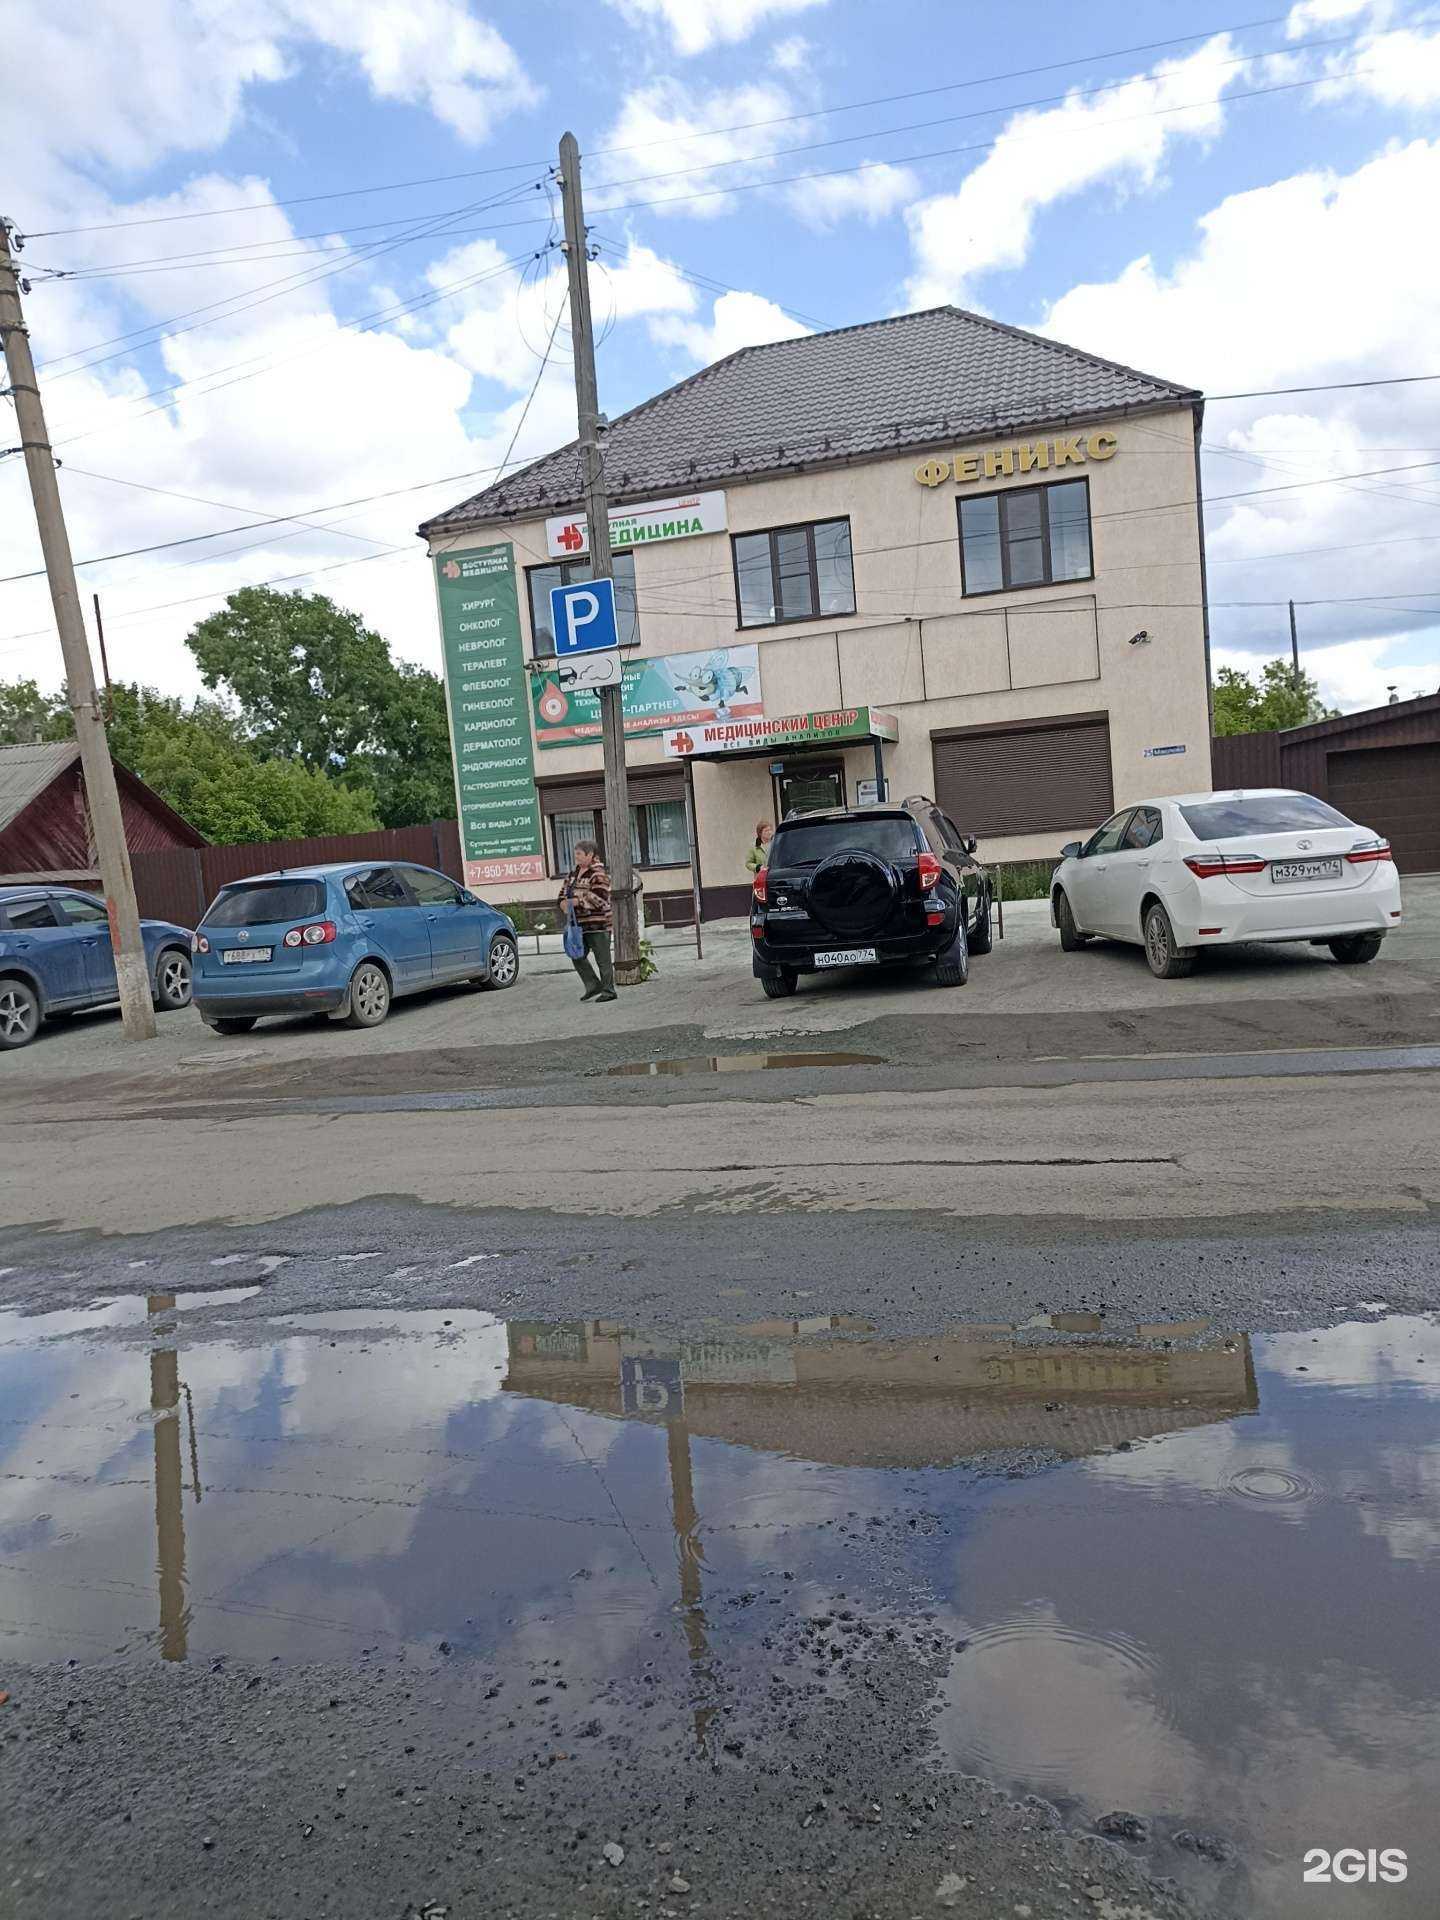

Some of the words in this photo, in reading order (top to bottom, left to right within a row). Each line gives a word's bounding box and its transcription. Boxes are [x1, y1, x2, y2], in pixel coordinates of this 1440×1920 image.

[914, 431, 1118, 487] ФЕНИКС
[582, 518, 637, 534] ДУПНАЯ
[609, 517, 703, 546] ЕДИЦИНА
[462, 556, 509, 570] ДОСТУПНАЯ
[462, 564, 509, 577] МЕДИЦИНА
[462, 598, 496, 611] ХИРУРГ
[459, 618, 502, 632] ОНКОЛОГ
[565, 591, 599, 646] P
[458, 638, 507, 652] НЕВРОЛОГ
[462, 658, 508, 672] ТЕРАПЕВТ
[462, 678, 512, 692] ФЛЕБОЛОГ
[462, 698, 514, 713] ГИНЕКОЛОГ
[464, 717, 518, 732] КАРДИОЛОГ
[632, 717, 671, 729] АНАЛИЗЫ
[704, 716, 808, 742] МЕДИЦИНСКИЙ
[813, 709, 858, 728] ЦЕНТР
[463, 737, 523, 753] ДЕРМАТОЛОГ
[723, 741, 740, 749] ВСЕ
[749, 737, 777, 747] ВИДЫ
[462, 757, 528, 772] ЭНДОКРИНОЛОГ
[463, 777, 530, 791] ГАСТРОЭНТЕРОЛОГ
[470, 821, 487, 830] Все
[488, 820, 512, 830] виды
[513, 816, 531, 826] УЗИ
